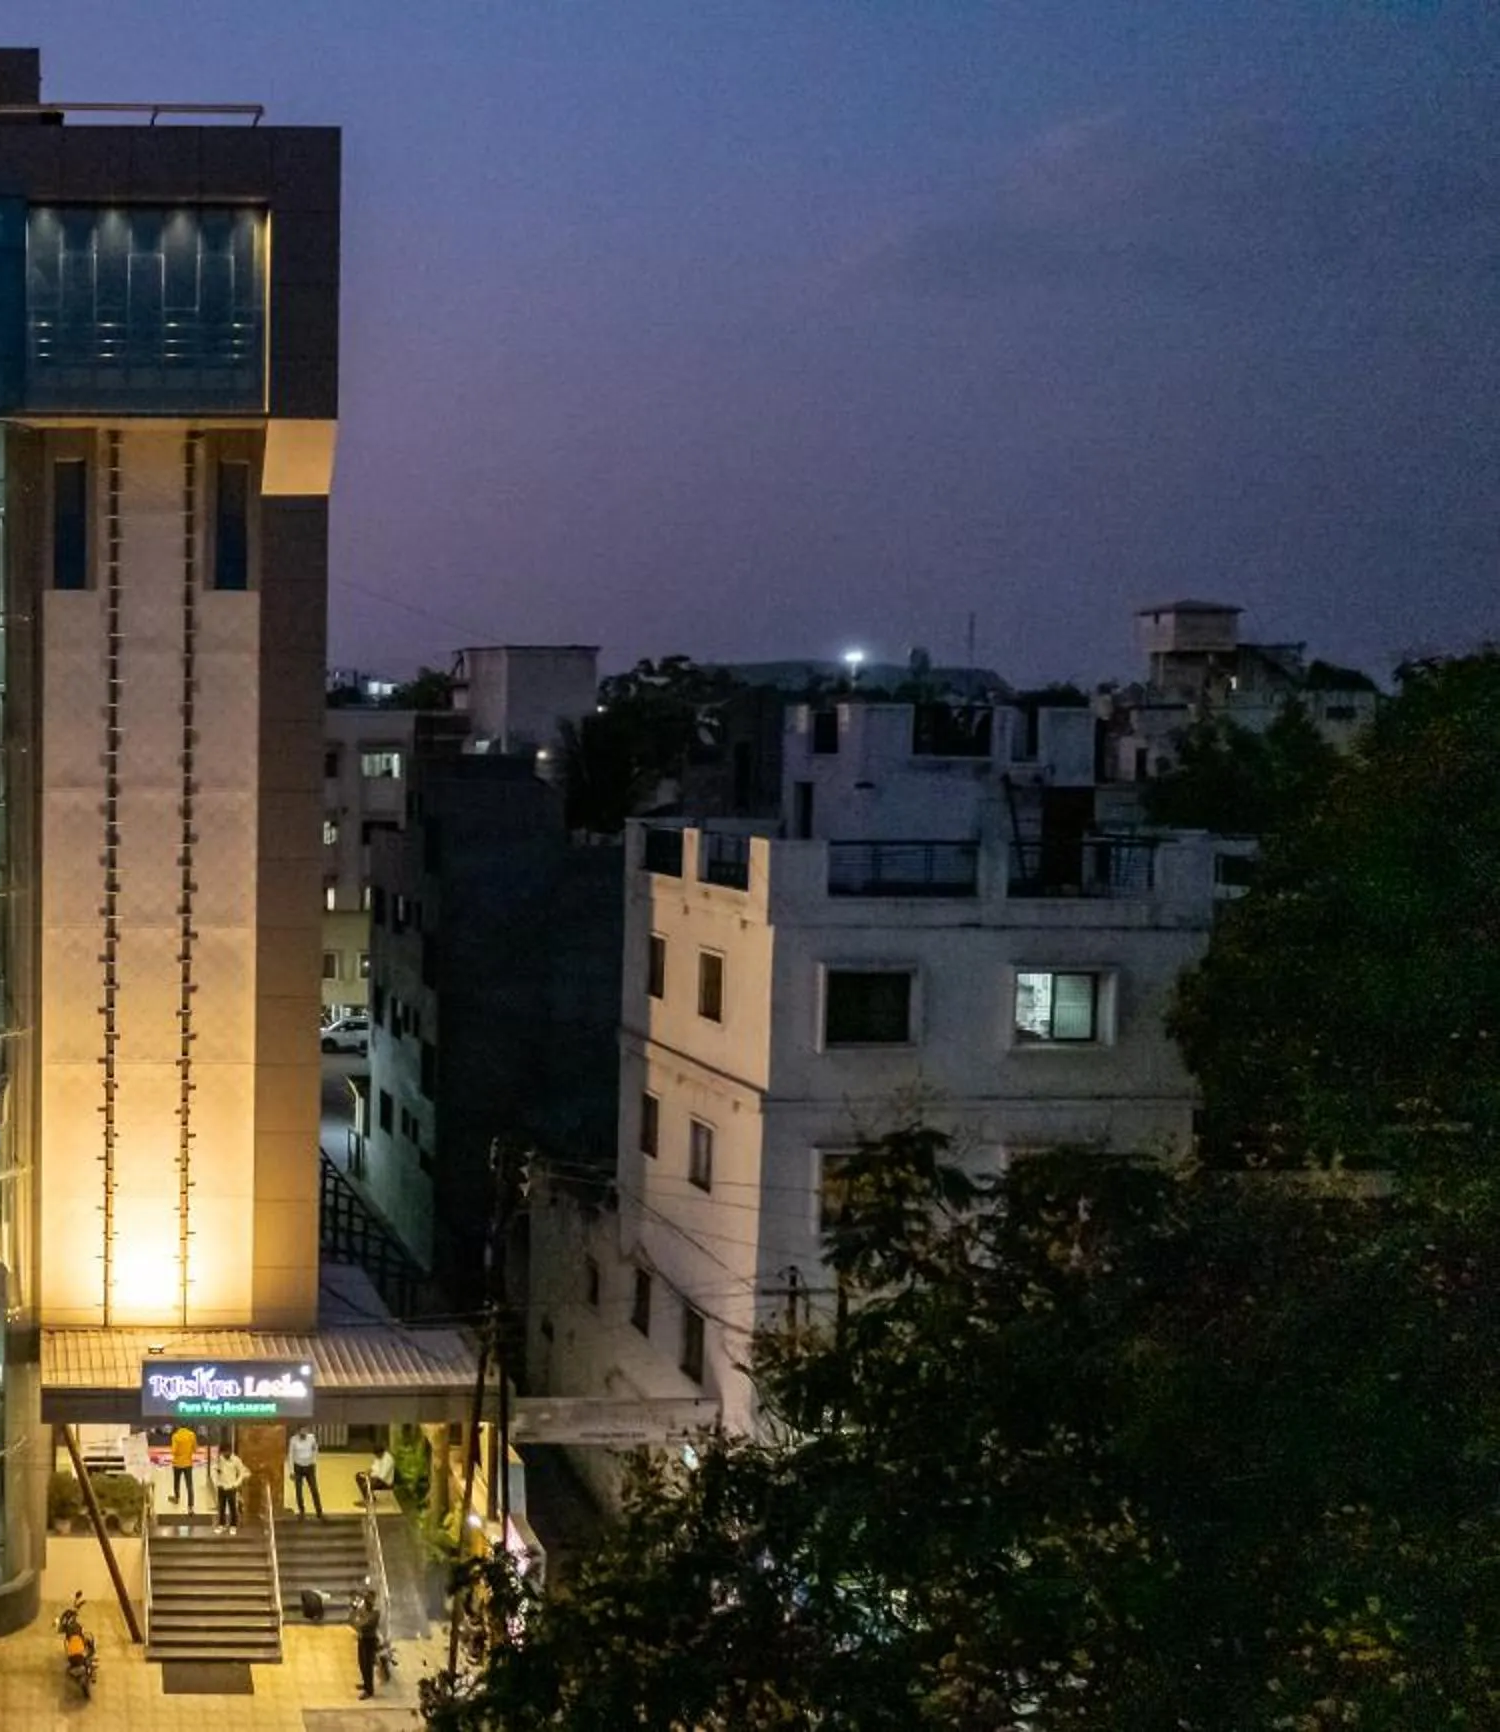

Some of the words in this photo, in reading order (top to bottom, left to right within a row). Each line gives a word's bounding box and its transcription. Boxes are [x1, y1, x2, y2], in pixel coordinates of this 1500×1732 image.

[149, 1367, 241, 1401] Krishna
[178, 1402, 201, 1413] Pure
[202, 1402, 222, 1415] Veg
[224, 1402, 277, 1413] Restaurant
